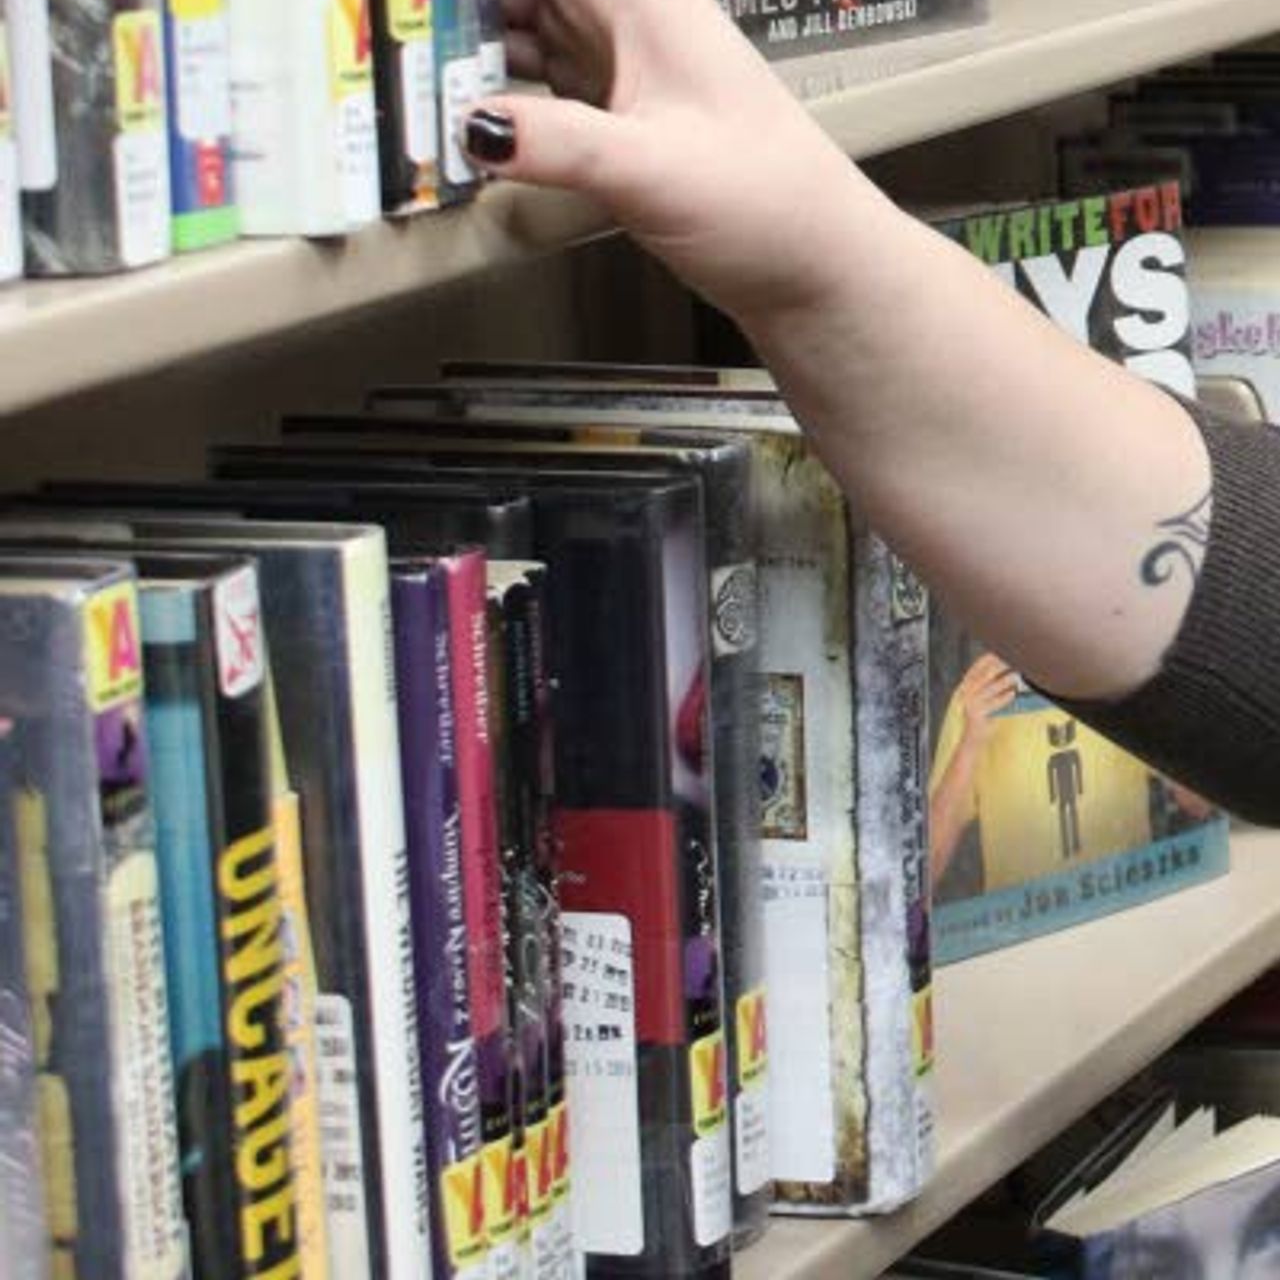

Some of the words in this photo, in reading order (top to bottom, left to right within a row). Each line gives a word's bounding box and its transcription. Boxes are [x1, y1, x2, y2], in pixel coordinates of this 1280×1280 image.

[767, 17, 800, 44] AND
[801, 12, 834, 40] JILL
[966, 195, 1109, 265] WRITE
[1108, 177, 1183, 243] FOR
[990, 228, 1192, 352] YS
[470, 609, 491, 745] Schreiber
[1079, 843, 1201, 901] Scieszka
